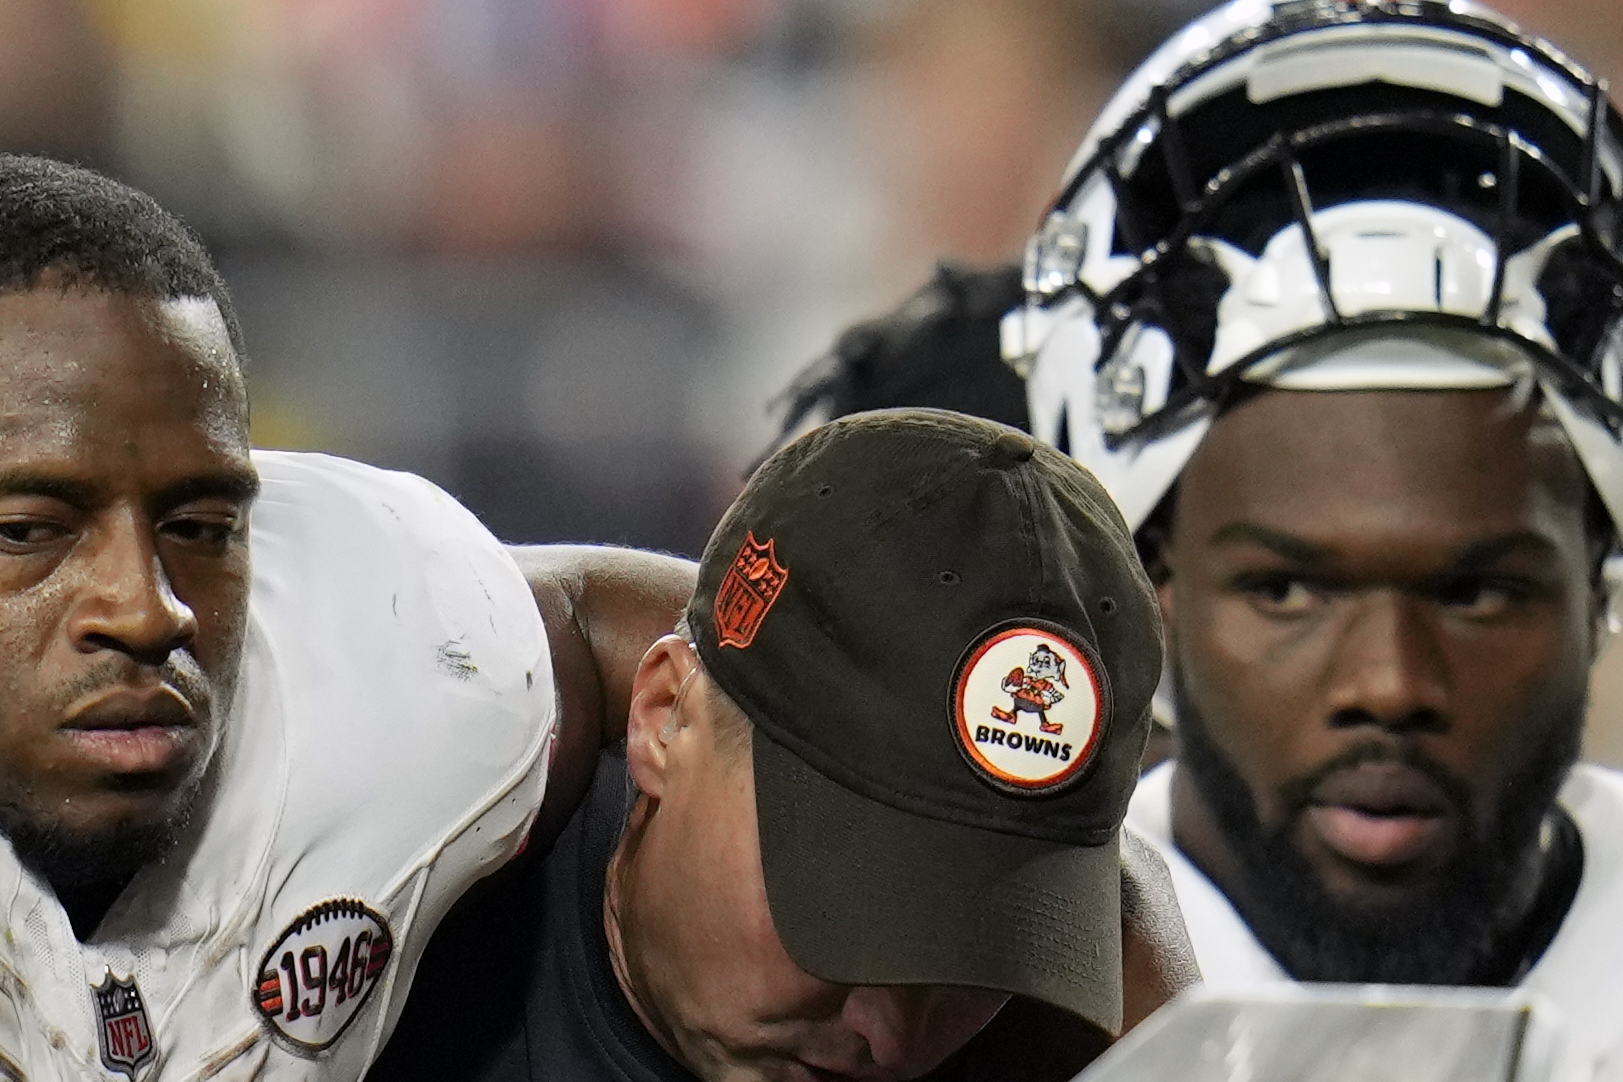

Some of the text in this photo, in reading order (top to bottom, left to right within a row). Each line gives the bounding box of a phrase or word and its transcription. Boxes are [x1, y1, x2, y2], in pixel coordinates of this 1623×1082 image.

[975, 725, 1073, 762] BROWNS
[280, 929, 373, 1022] 1946
[107, 1015, 149, 1060] NFL
